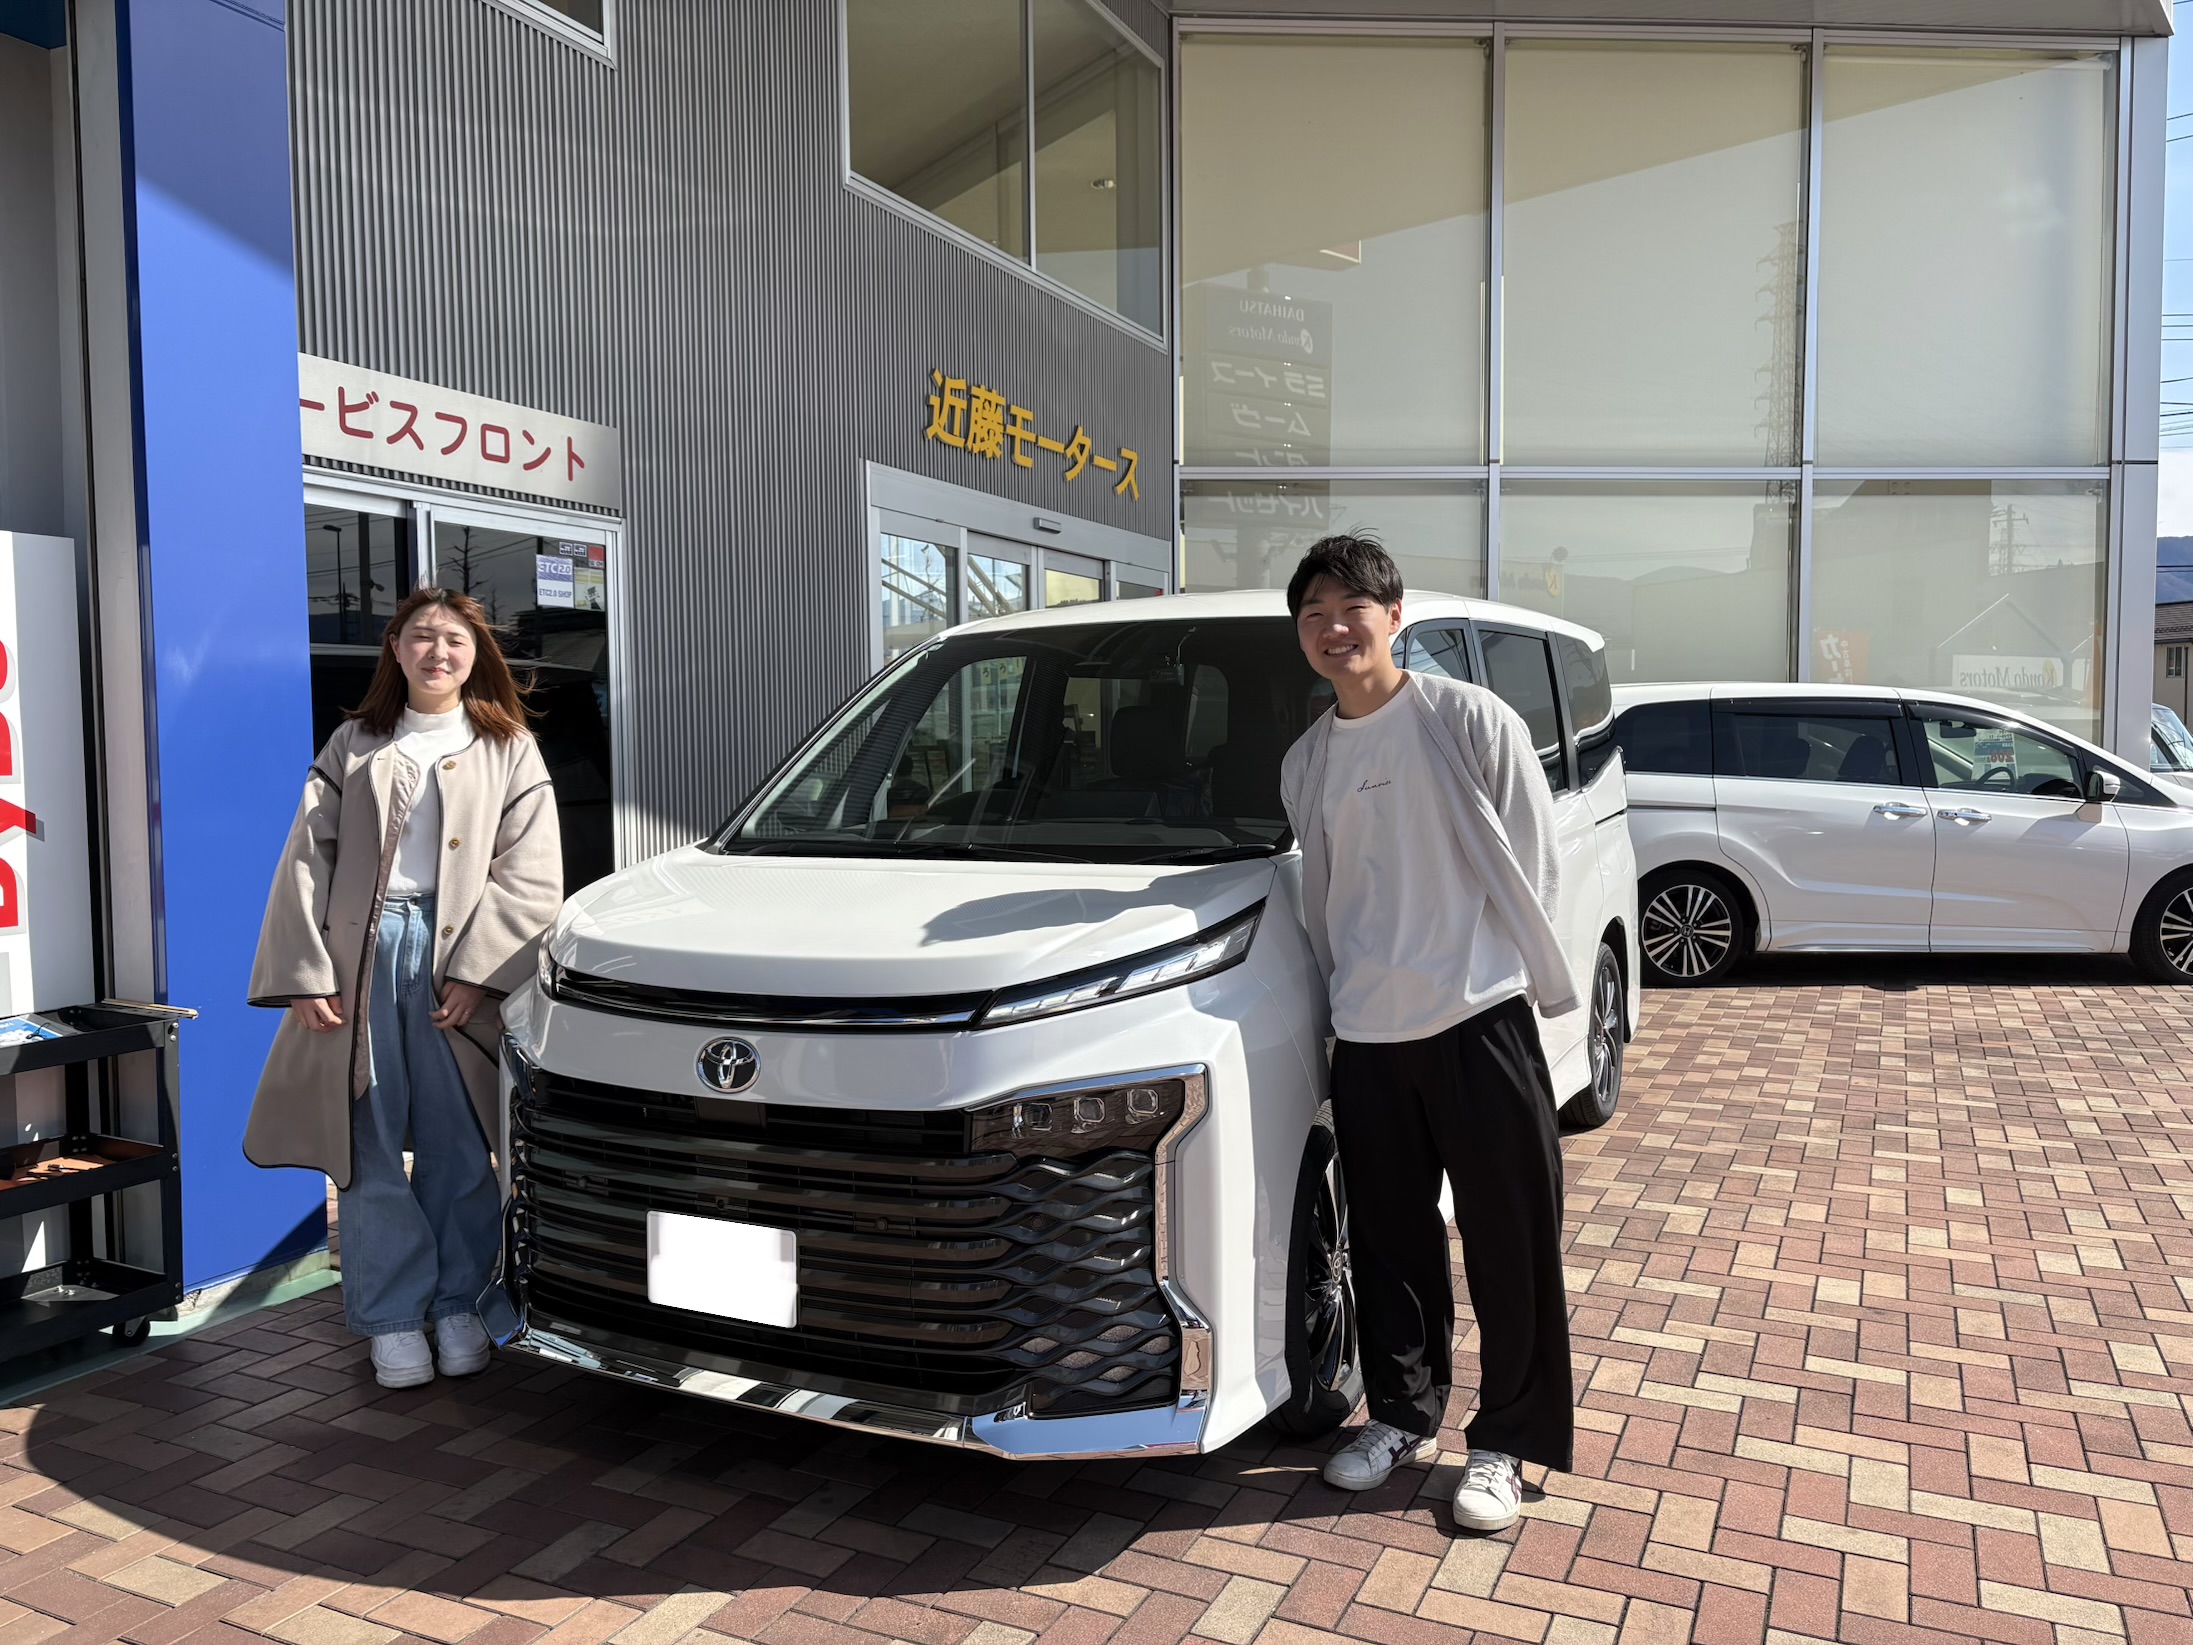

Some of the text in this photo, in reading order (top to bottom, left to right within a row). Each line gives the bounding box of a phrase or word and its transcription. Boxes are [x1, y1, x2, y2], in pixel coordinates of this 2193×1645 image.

[299, 386, 585, 481] ービスフロント
[925, 368, 1140, 501] 近藤モータース
[538, 561, 557, 574] ETC
[558, 590, 572, 599] SHOP
